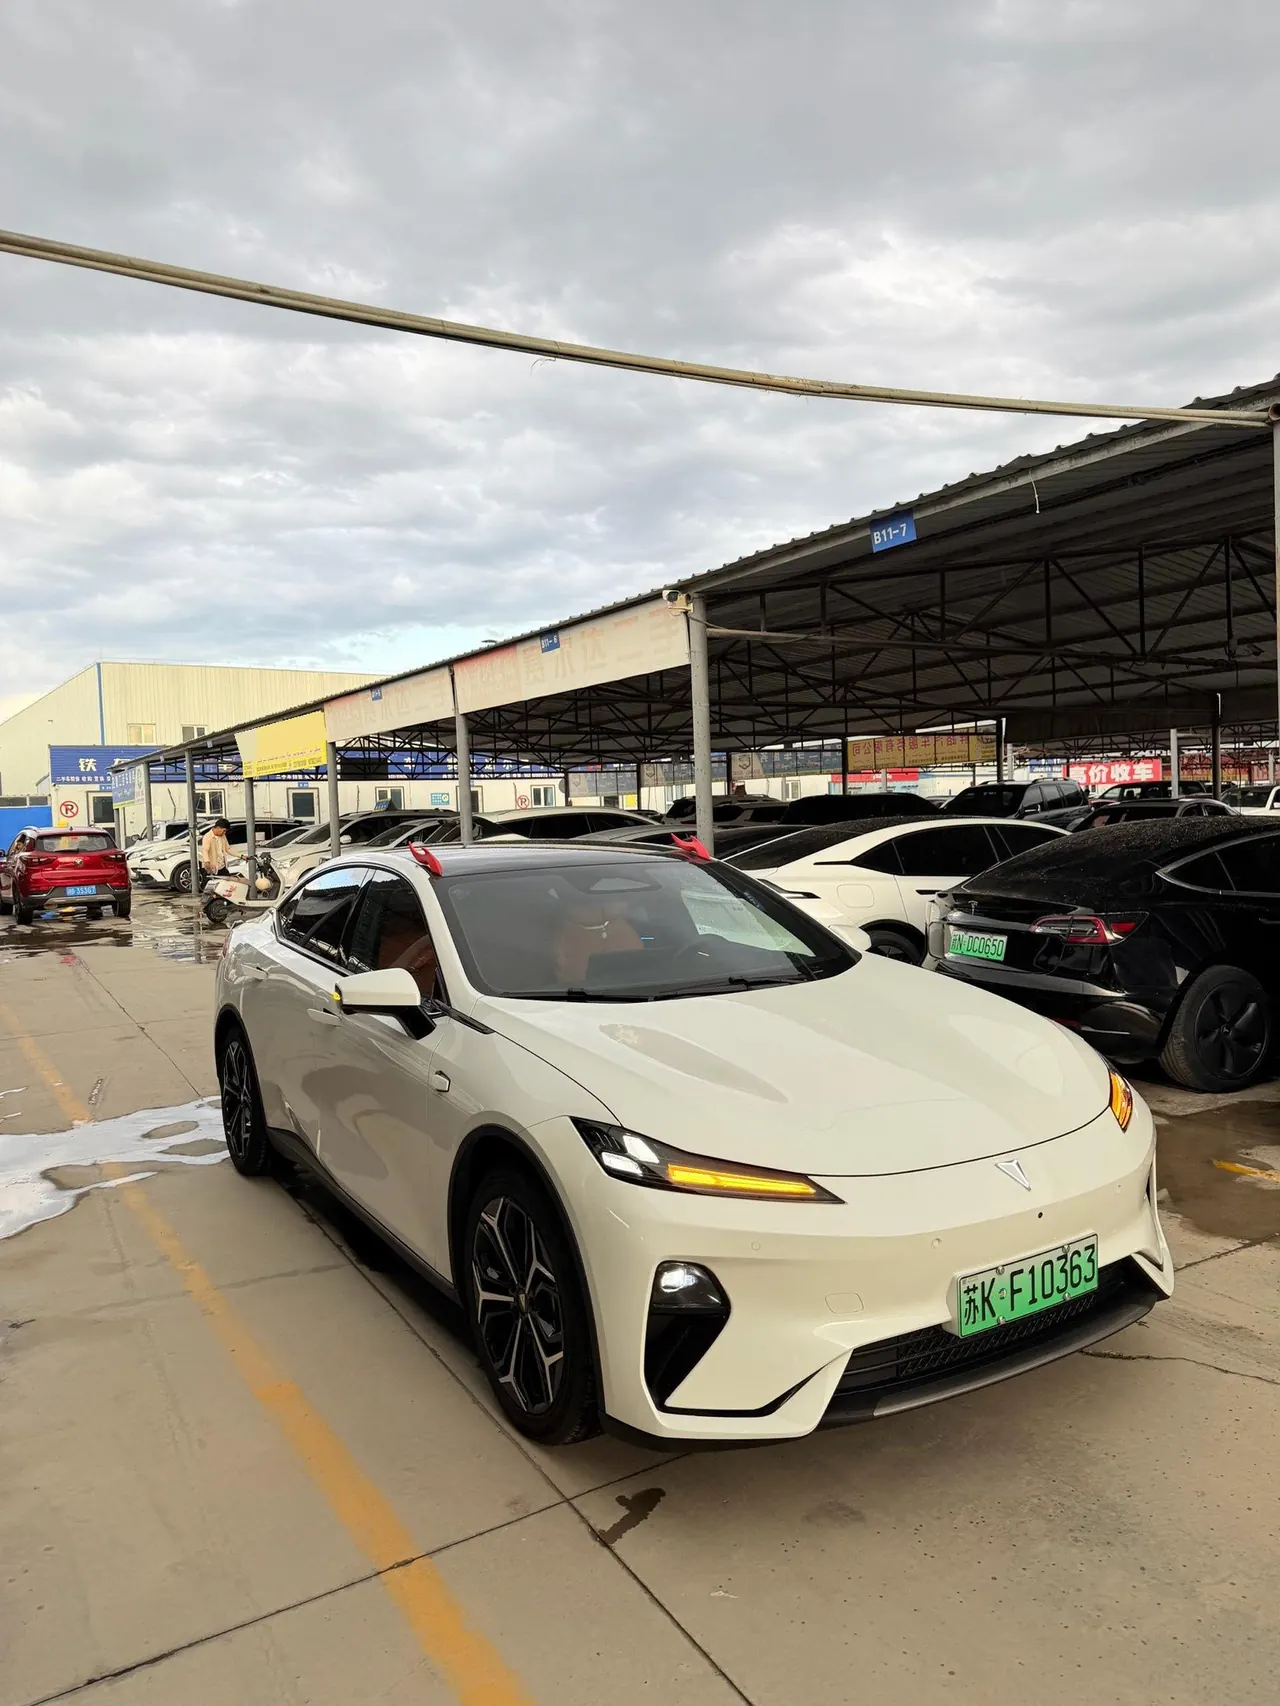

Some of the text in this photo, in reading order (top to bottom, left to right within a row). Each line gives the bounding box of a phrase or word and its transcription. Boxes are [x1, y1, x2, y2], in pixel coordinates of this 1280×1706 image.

[873, 523, 907, 545] B11-7
[1069, 762, 1154, 785] 高价收车
